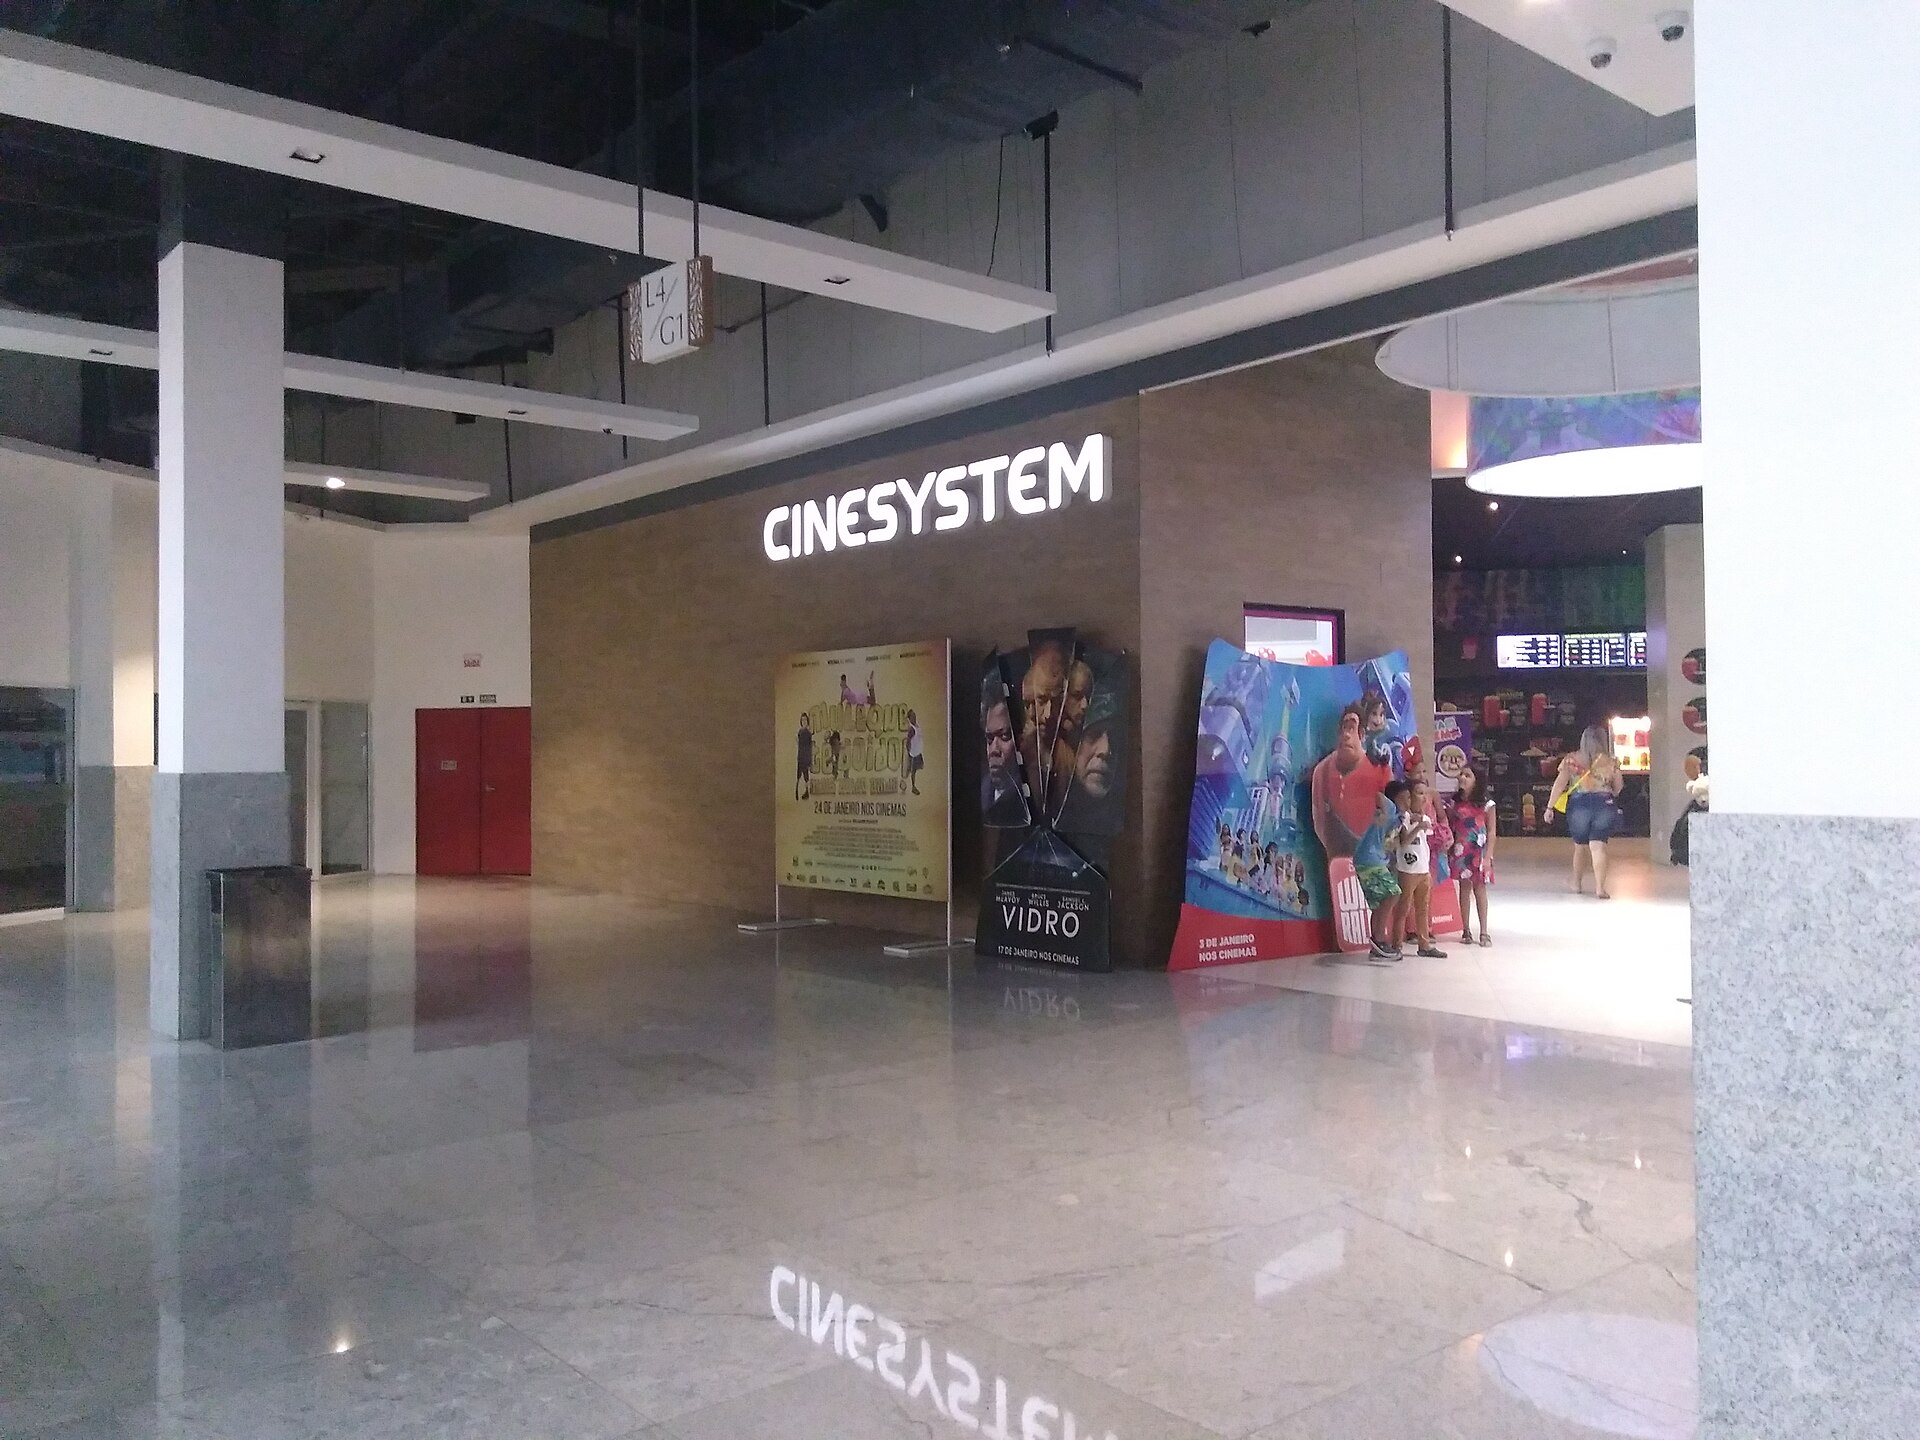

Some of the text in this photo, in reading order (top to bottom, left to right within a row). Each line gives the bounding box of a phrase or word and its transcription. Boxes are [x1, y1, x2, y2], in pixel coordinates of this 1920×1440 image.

[646, 276, 666, 308] L4
[660, 313, 683, 345] G1
[763, 432, 1107, 562] CINESYSTEM
[814, 801, 907, 818] 24 DE JANEIRO NOS CINEMAS
[1057, 900, 1090, 911] JACKSON
[1002, 904, 1080, 938] VIDRO
[1206, 937, 1218, 948] DE
[1219, 933, 1255, 947] JANEIRO
[998, 945, 1080, 966] 17 DE JANEIRO NOS CINEMAS
[1199, 946, 1257, 962] NOS CINEMAS
